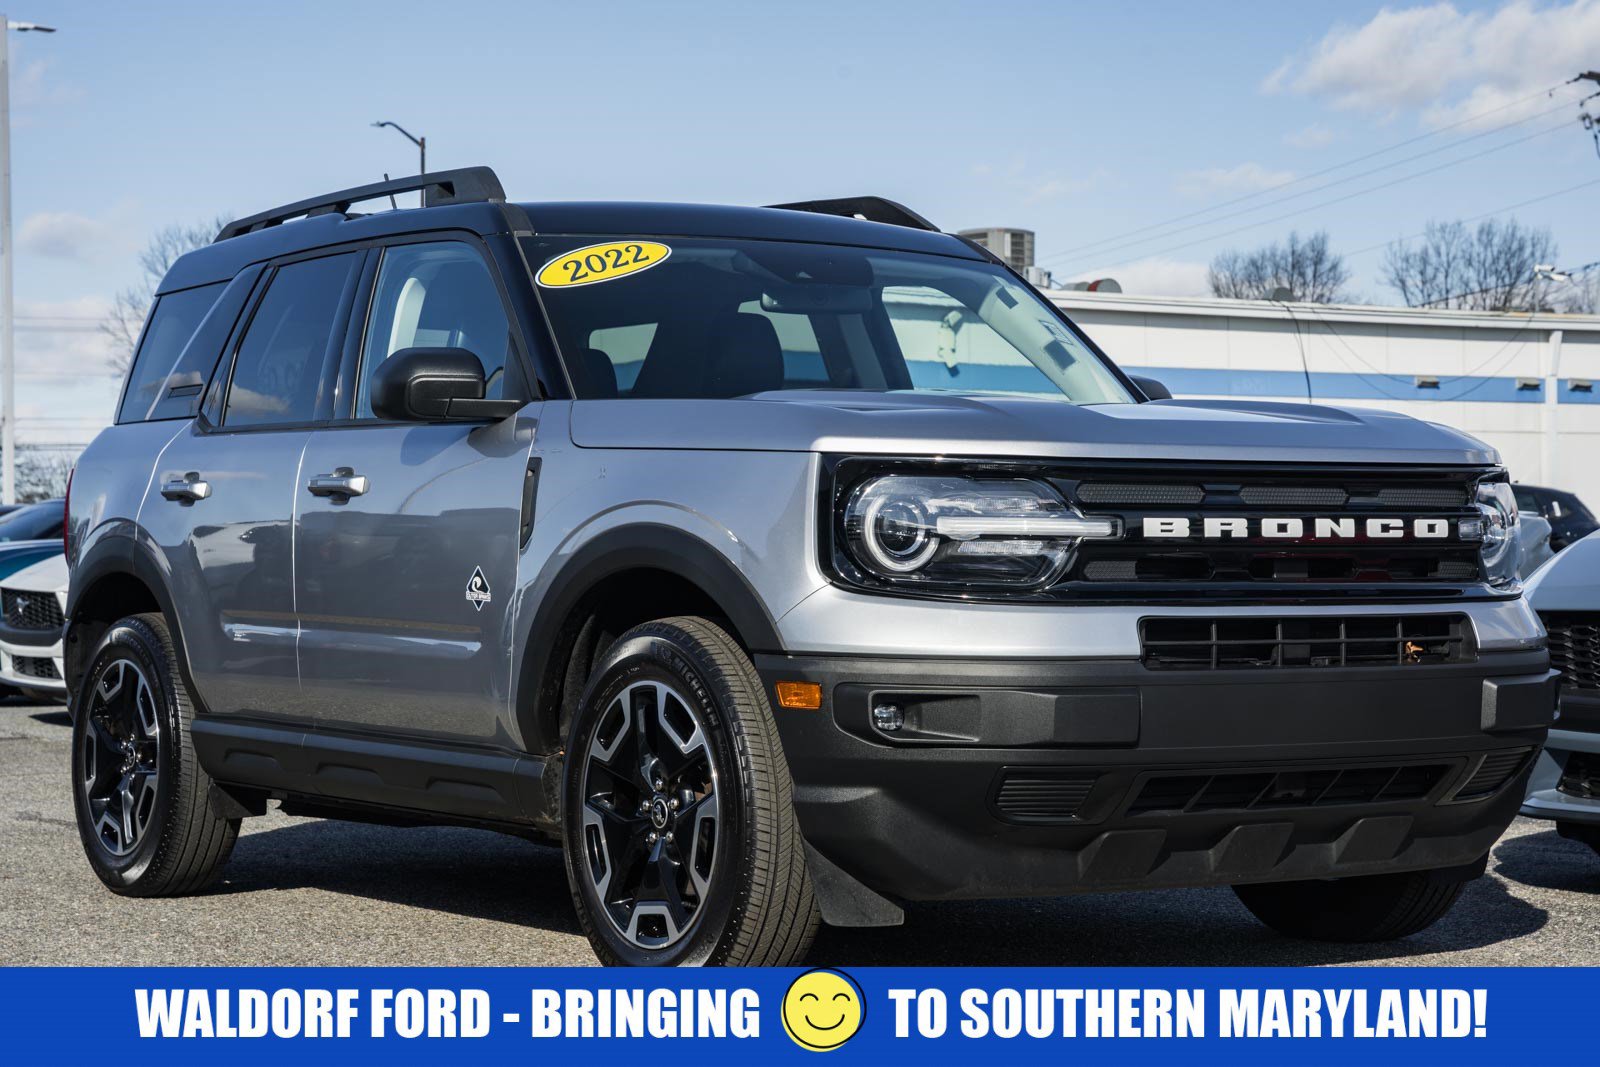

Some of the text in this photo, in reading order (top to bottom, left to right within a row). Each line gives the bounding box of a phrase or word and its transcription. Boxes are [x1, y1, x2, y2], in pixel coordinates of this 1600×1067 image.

[563, 246, 650, 282] 2022
[1143, 517, 1449, 538] BRONCO
[672, 657, 719, 726] MICHELIN
